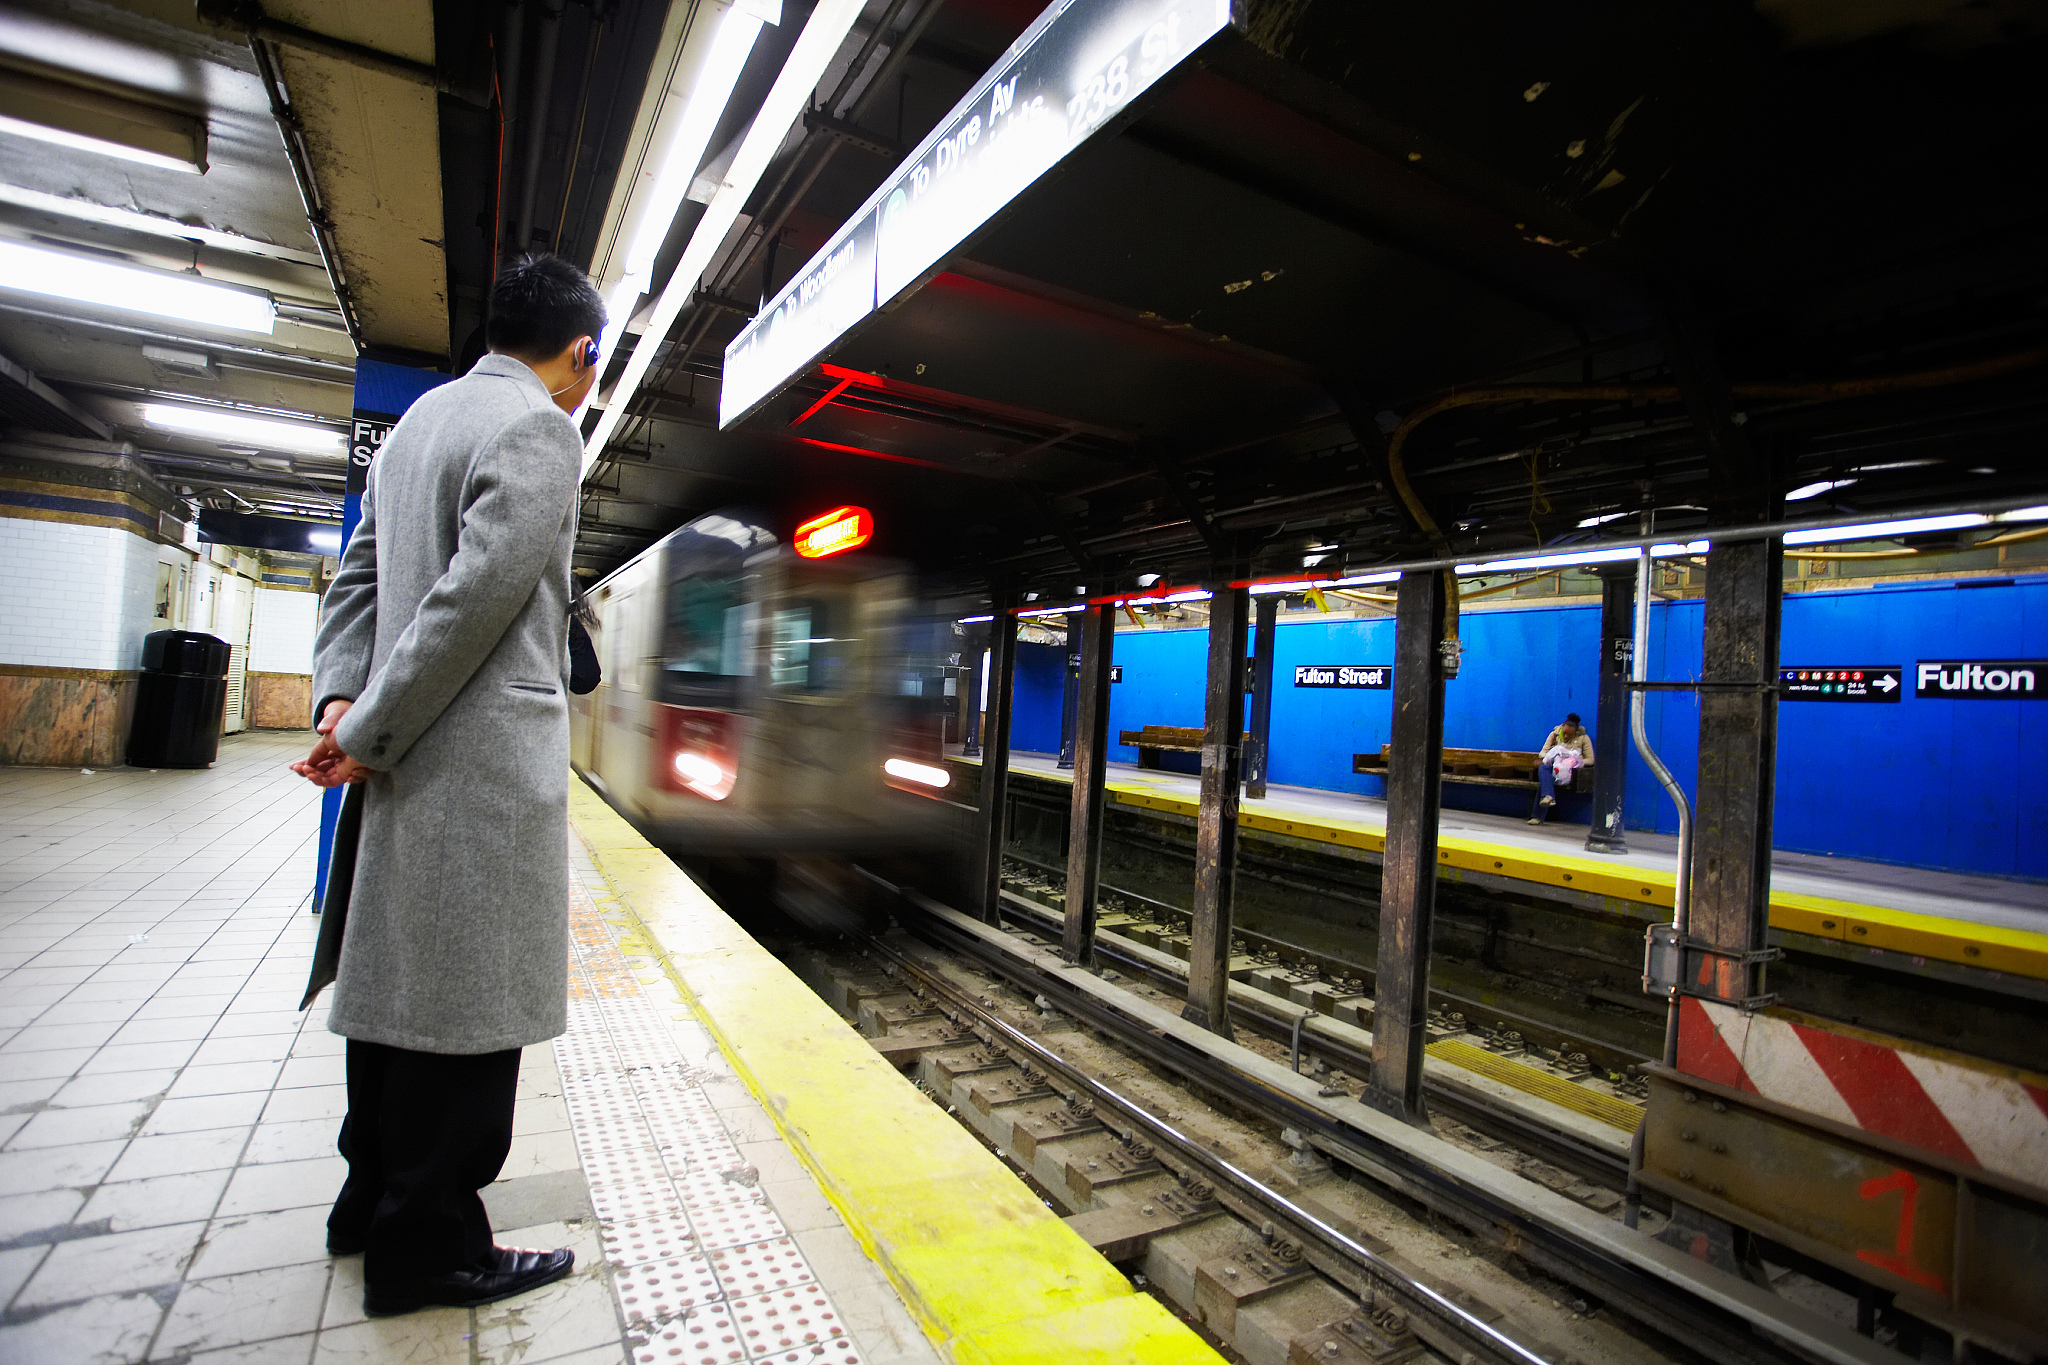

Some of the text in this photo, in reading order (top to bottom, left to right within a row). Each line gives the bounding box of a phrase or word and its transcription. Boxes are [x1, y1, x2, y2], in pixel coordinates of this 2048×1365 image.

[1068, 55, 1129, 140] 238
[1139, 10, 1182, 78] St
[909, 163, 931, 201] To
[936, 115, 981, 179] Dyre
[988, 76, 1017, 128] Av
[785, 294, 798, 320] To
[800, 239, 855, 308] Woodlawn
[352, 446, 378, 467] S
[1295, 667, 1384, 685] Fulton Street
[1917, 663, 2035, 691] Fulton
